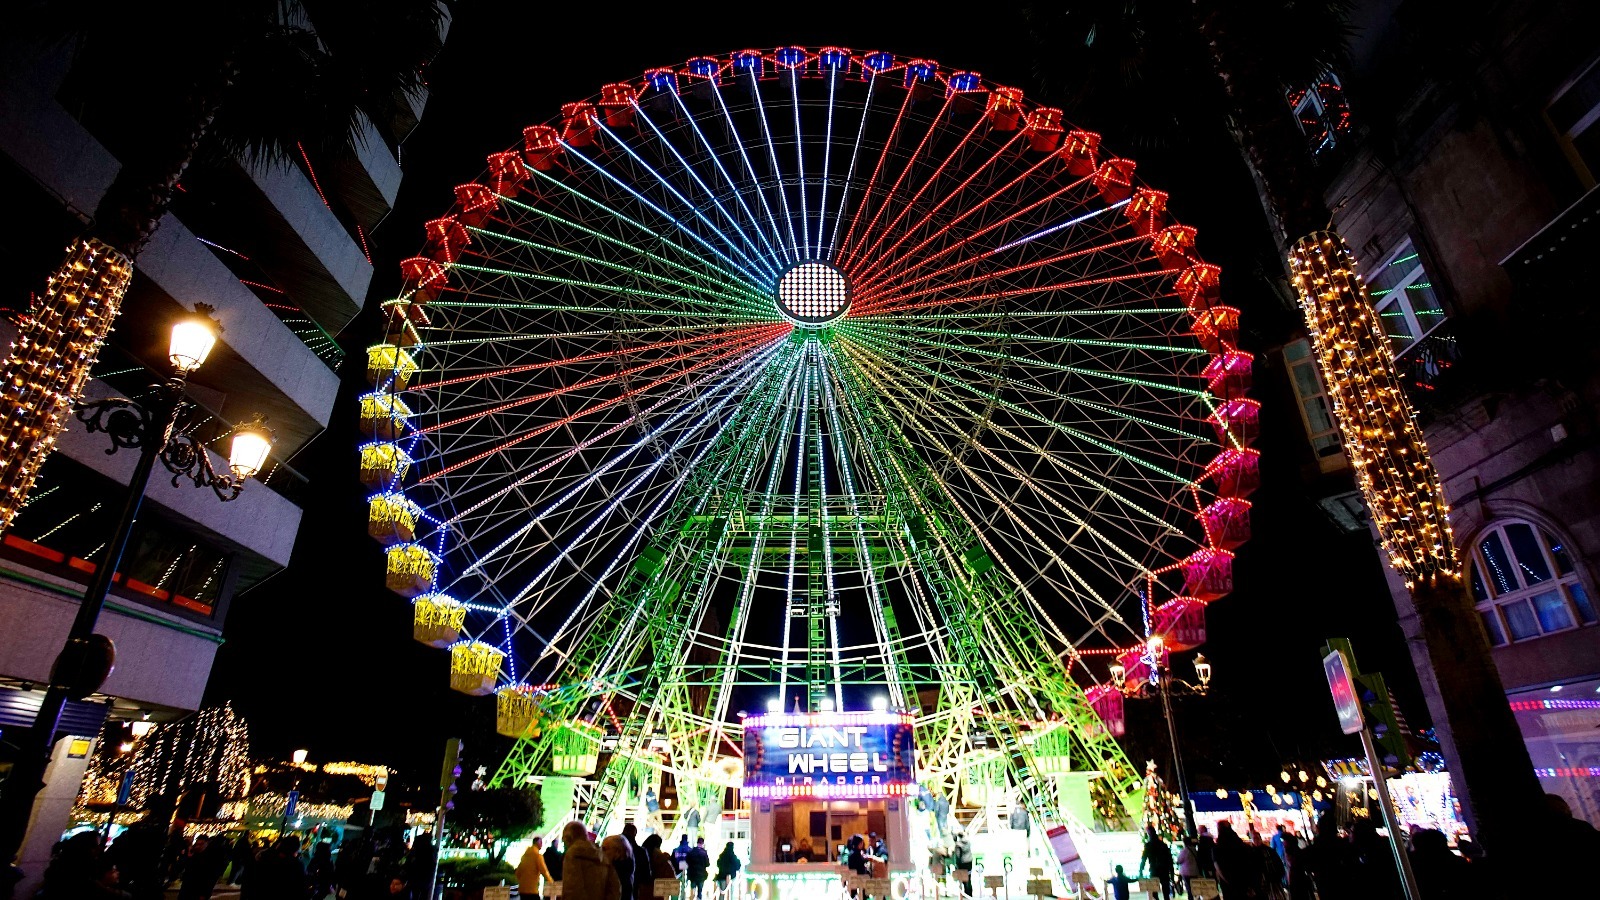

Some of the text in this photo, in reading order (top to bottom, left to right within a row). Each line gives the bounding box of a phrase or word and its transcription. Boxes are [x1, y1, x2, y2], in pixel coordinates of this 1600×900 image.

[778, 726, 868, 748] GIANT
[788, 752, 887, 774] WHEEL
[775, 776, 881, 786] MIRADOR
[975, 857, 985, 873] 5
[1003, 857, 1014, 873] 6
